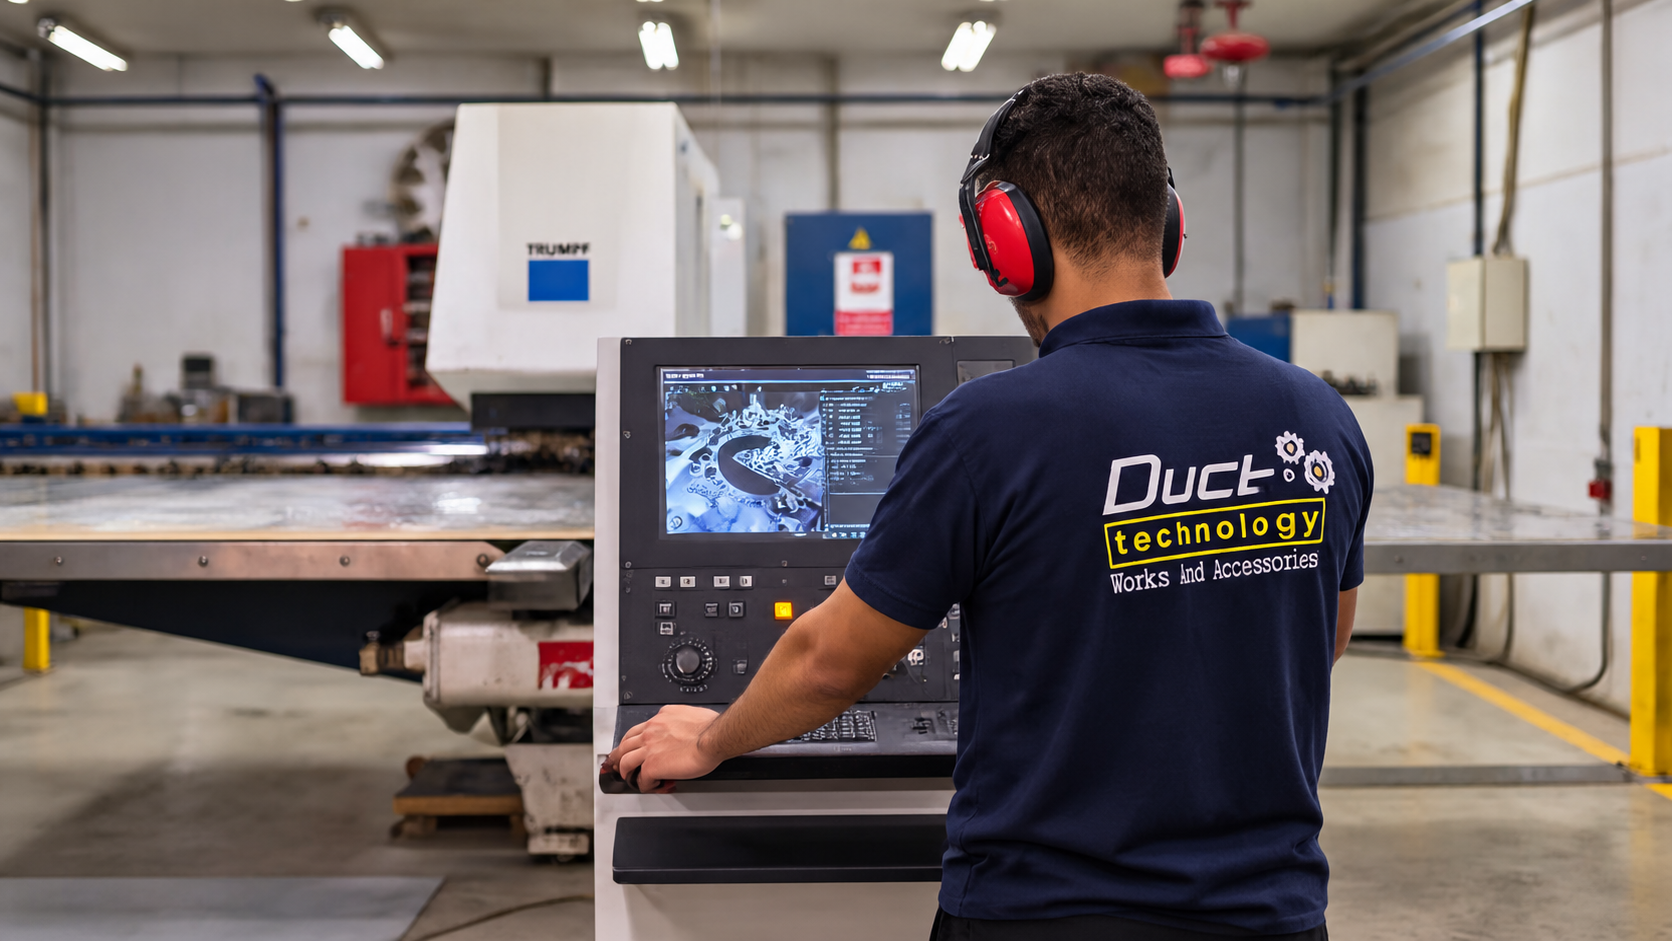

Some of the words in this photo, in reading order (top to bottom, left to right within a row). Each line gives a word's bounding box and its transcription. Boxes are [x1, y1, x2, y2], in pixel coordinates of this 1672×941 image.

[527, 243, 590, 255] TRUMPF
[1102, 454, 1274, 515] Duct
[1114, 510, 1319, 554] technology
[1110, 568, 1170, 594] Works
[1179, 562, 1205, 584] And
[1213, 548, 1319, 580] Accessories
